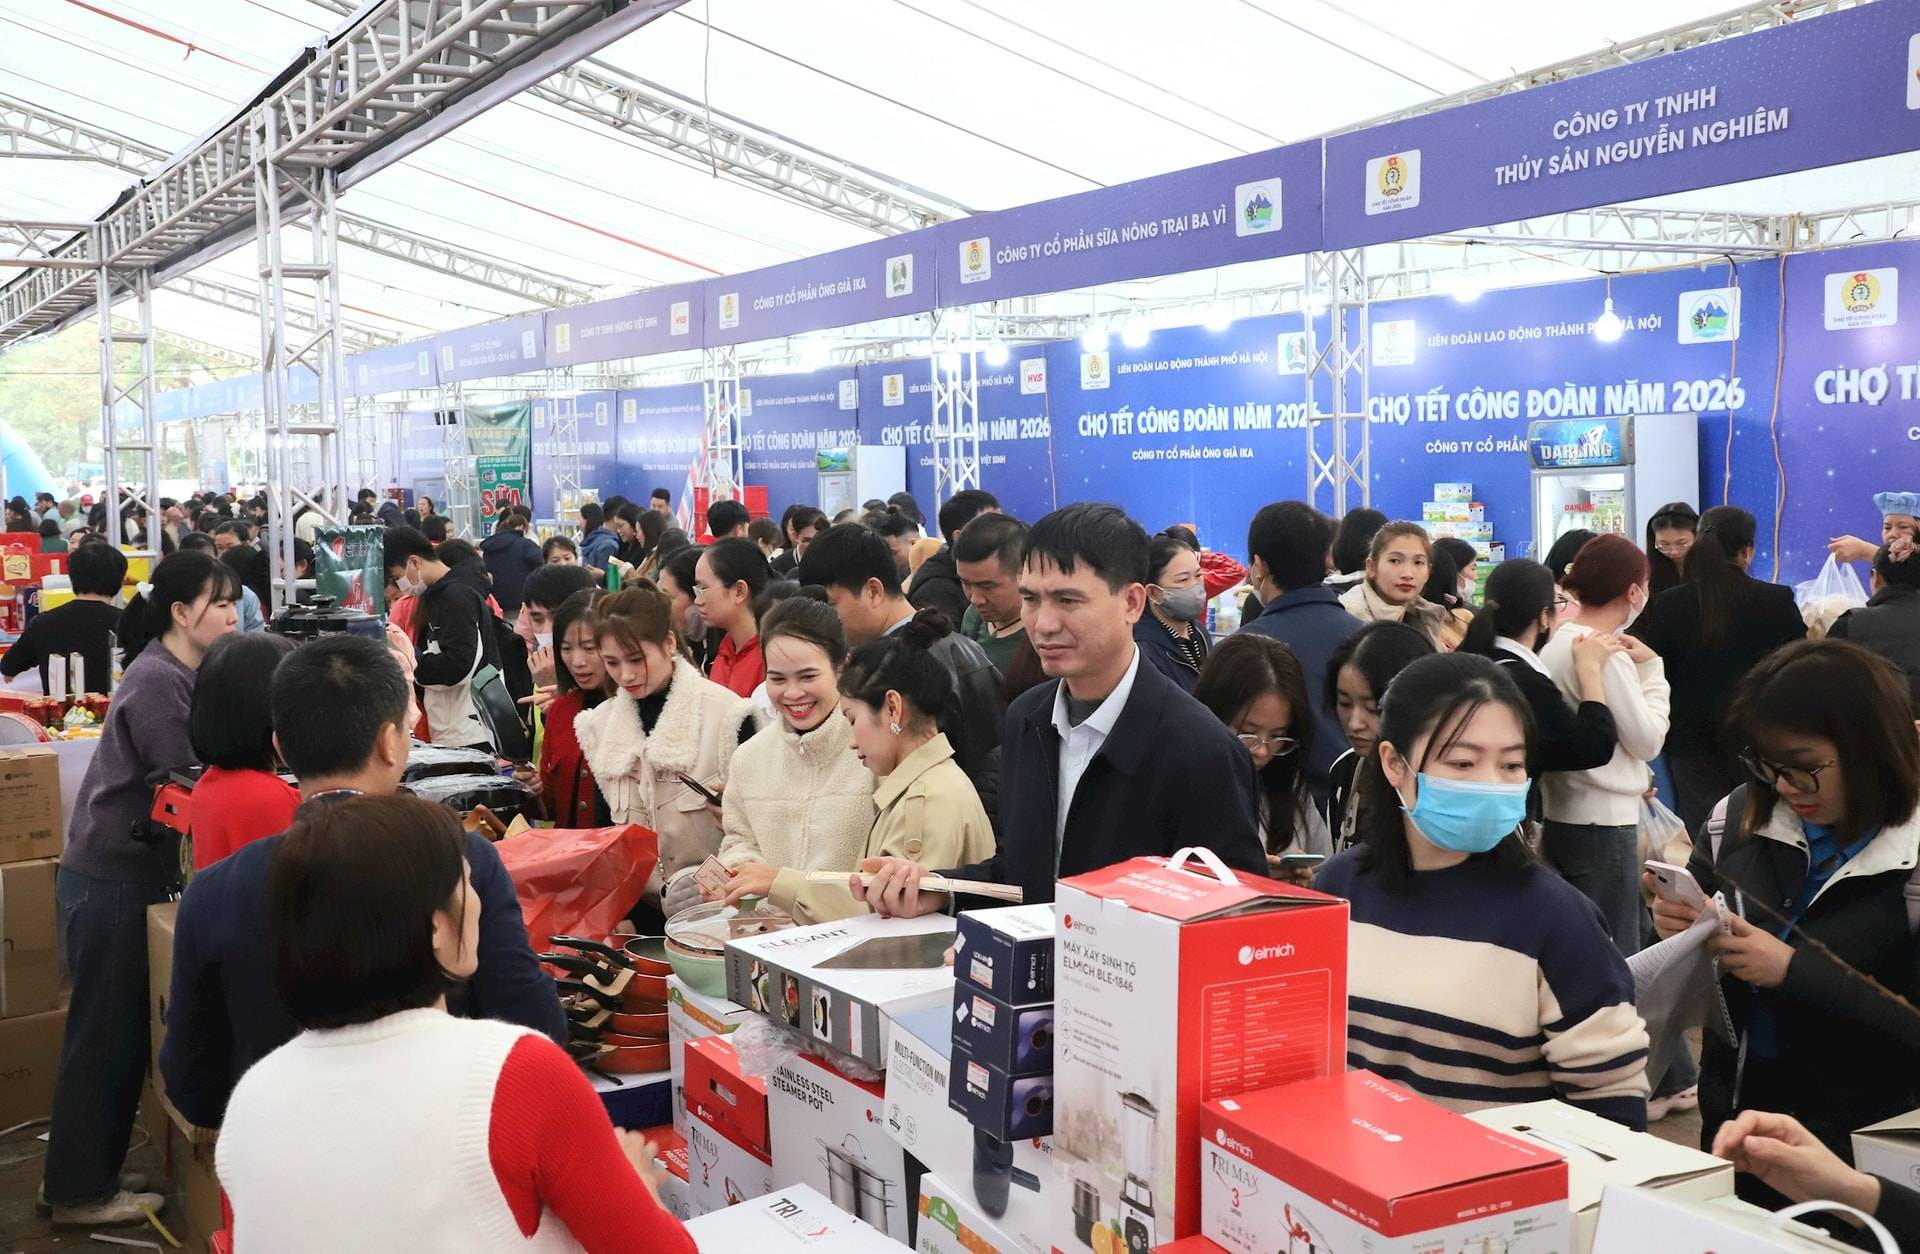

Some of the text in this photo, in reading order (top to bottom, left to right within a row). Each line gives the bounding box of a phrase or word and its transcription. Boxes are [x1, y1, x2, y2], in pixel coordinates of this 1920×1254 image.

[1553, 86, 1717, 140] CÔNG TY TNHH
[1495, 106, 1789, 185] THỦY SẢN NGUYỄN NGHIÊM
[996, 204, 1227, 265] CÔNG TY CỔ PHẦN SỮA NÔNG TRẠI BA VÌ
[753, 277, 867, 311] CÔNG TY CỔ PHẦN ÔNG GIÀ IKA
[1428, 334, 1448, 348] LIÊN
[1450, 330, 1481, 346] ĐOÀN
[1484, 330, 1505, 344] LAO
[1508, 325, 1542, 344] ĐỘNG
[1545, 320, 1584, 337] THÀNH
[1637, 313, 1662, 334] NỘI
[1117, 350, 1268, 374] LIÊN ĐOÀN LAO ĐỘNG THÀNH PHỐ HÀ NỘI
[1027, 374, 1043, 383] HVS
[1814, 363, 1889, 405] CHỢ
[1368, 376, 1745, 426] CHỢ TẾT CÔNG ĐOÀN NĂM 2026
[881, 415, 1051, 446] CHỢ TẾT NĂM 2026
[1078, 411, 1108, 438] CHỢ
[1110, 405, 1134, 435] TẾT
[1137, 406, 1179, 434] CÔNG
[1183, 402, 1229, 432] ĐOÀN
[1233, 401, 1273, 430] NĂM
[753, 429, 766, 451] TẾT
[767, 430, 790, 450] CÔNG
[791, 429, 815, 449] ĐOÀN
[817, 428, 837, 448] NĂM
[1132, 446, 1254, 460] CÔNG TY CỔ PHẦN ÔNG GIÀ IKA
[1426, 434, 1527, 453] CÔNG TY CỔ PHẦN
[1541, 443, 1613, 460] DARLING
[758, 929, 848, 949] ELEGANT
[1073, 920, 1097, 936] elmich
[1083, 946, 1100, 962] XAY
[1101, 953, 1122, 971] SINH
[1124, 961, 1137, 976] TỐ
[1254, 943, 1295, 960] elmich
[1063, 955, 1095, 977] ELMICH
[1097, 968, 1134, 993] BLE-1846
[894, 1039, 934, 1080] MULTI-FUNCTION
[934, 1069, 946, 1089] MINI
[772, 1075, 824, 1112] STEAMER POT
[775, 1065, 835, 1104] TAINLESS STEEL
[691, 1126, 702, 1145] TRI
[1226, 1137, 1253, 1159] elmich
[703, 1162, 709, 1180] 3
[1211, 1151, 1258, 1190] TRI MAX
[1231, 1187, 1240, 1208] 3
